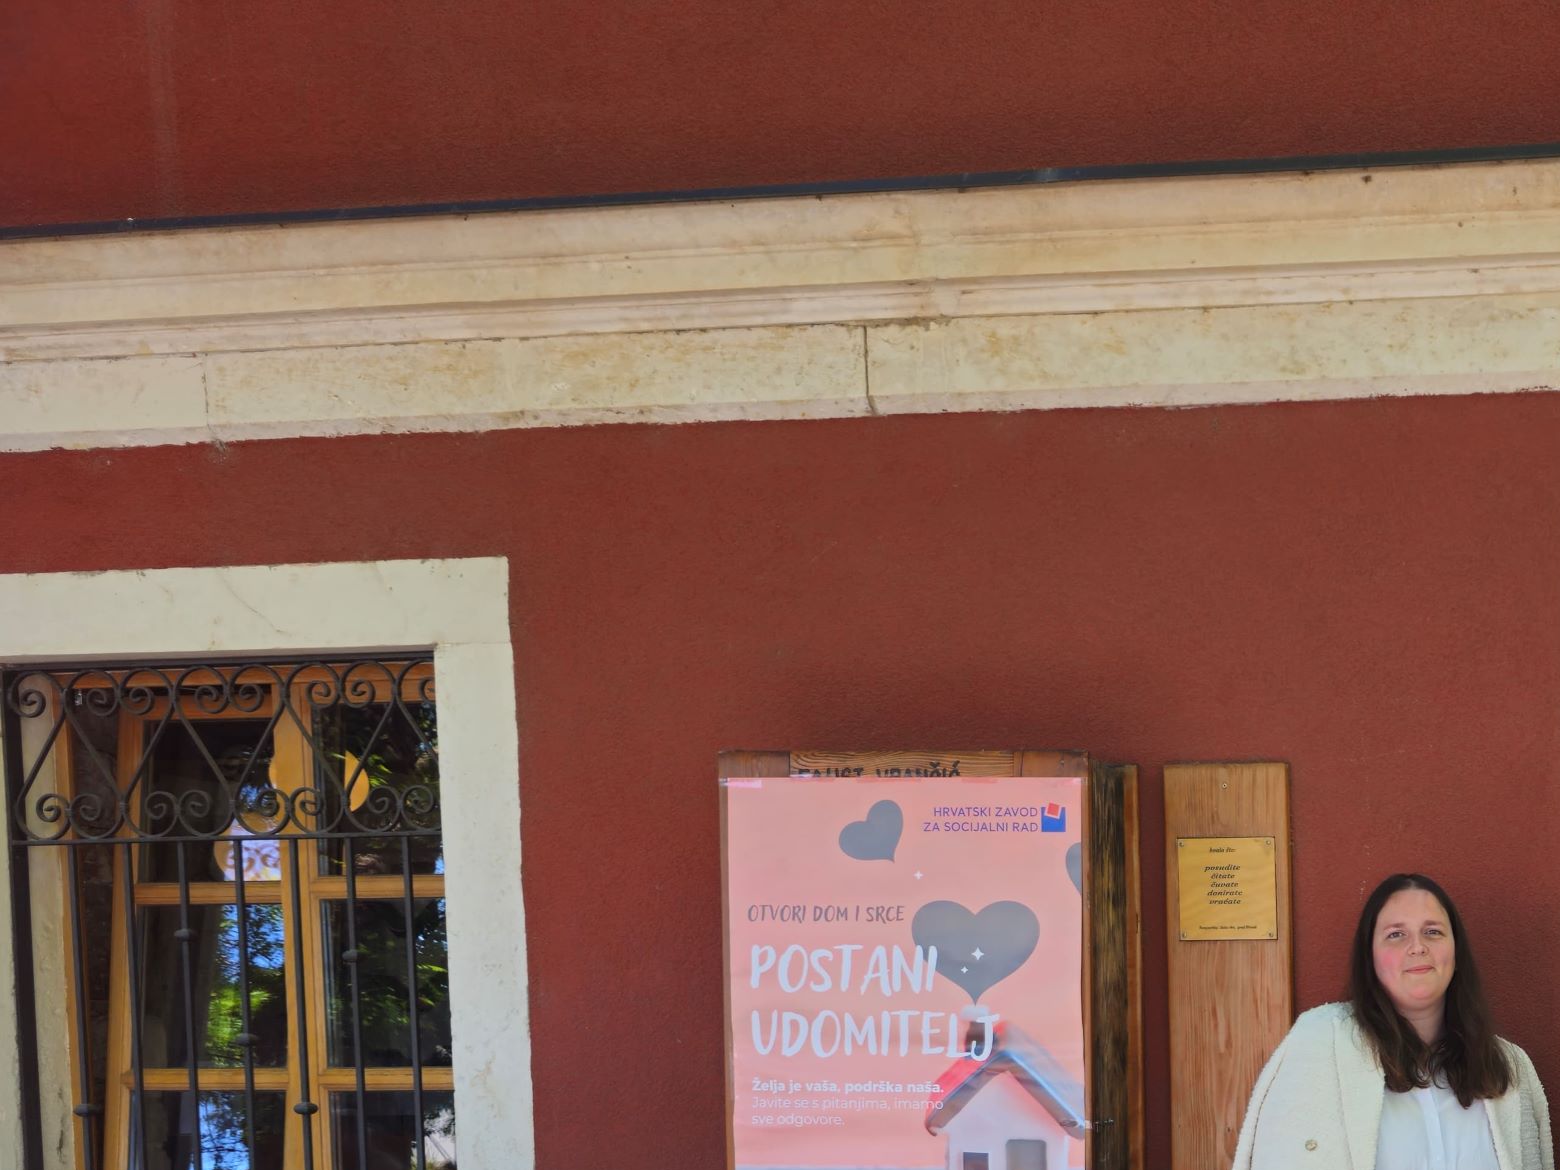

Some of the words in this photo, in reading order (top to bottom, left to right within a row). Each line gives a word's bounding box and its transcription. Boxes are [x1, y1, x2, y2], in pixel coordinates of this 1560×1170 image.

[933, 806, 992, 817] HRVATSKI
[995, 806, 1038, 817] ZAVOD
[923, 822, 941, 832] ZA
[943, 822, 1009, 832] SOCIJALNI
[1012, 822, 1039, 832] RAD
[1204, 864, 1241, 872] posudite
[748, 904, 806, 923] OTVORI
[813, 905, 848, 922] DOM
[855, 905, 860, 922] I
[866, 905, 905, 924] SRCE
[750, 944, 939, 997] POSTANI
[751, 1009, 1000, 1062] UDOMITELJ
[752, 1079, 785, 1094] Želja
[788, 1081, 801, 1094] je
[845, 1080, 902, 1094] podrška
[907, 1081, 944, 1093] naša.
[752, 1096, 791, 1109] Javite
[794, 1099, 808, 1109] se
[812, 1099, 819, 1109] s
[821, 1097, 891, 1111] pitanjima,
[895, 1098, 944, 1109] imamo
[752, 1115, 773, 1125] sve
[777, 1114, 845, 1127] odgovore.
